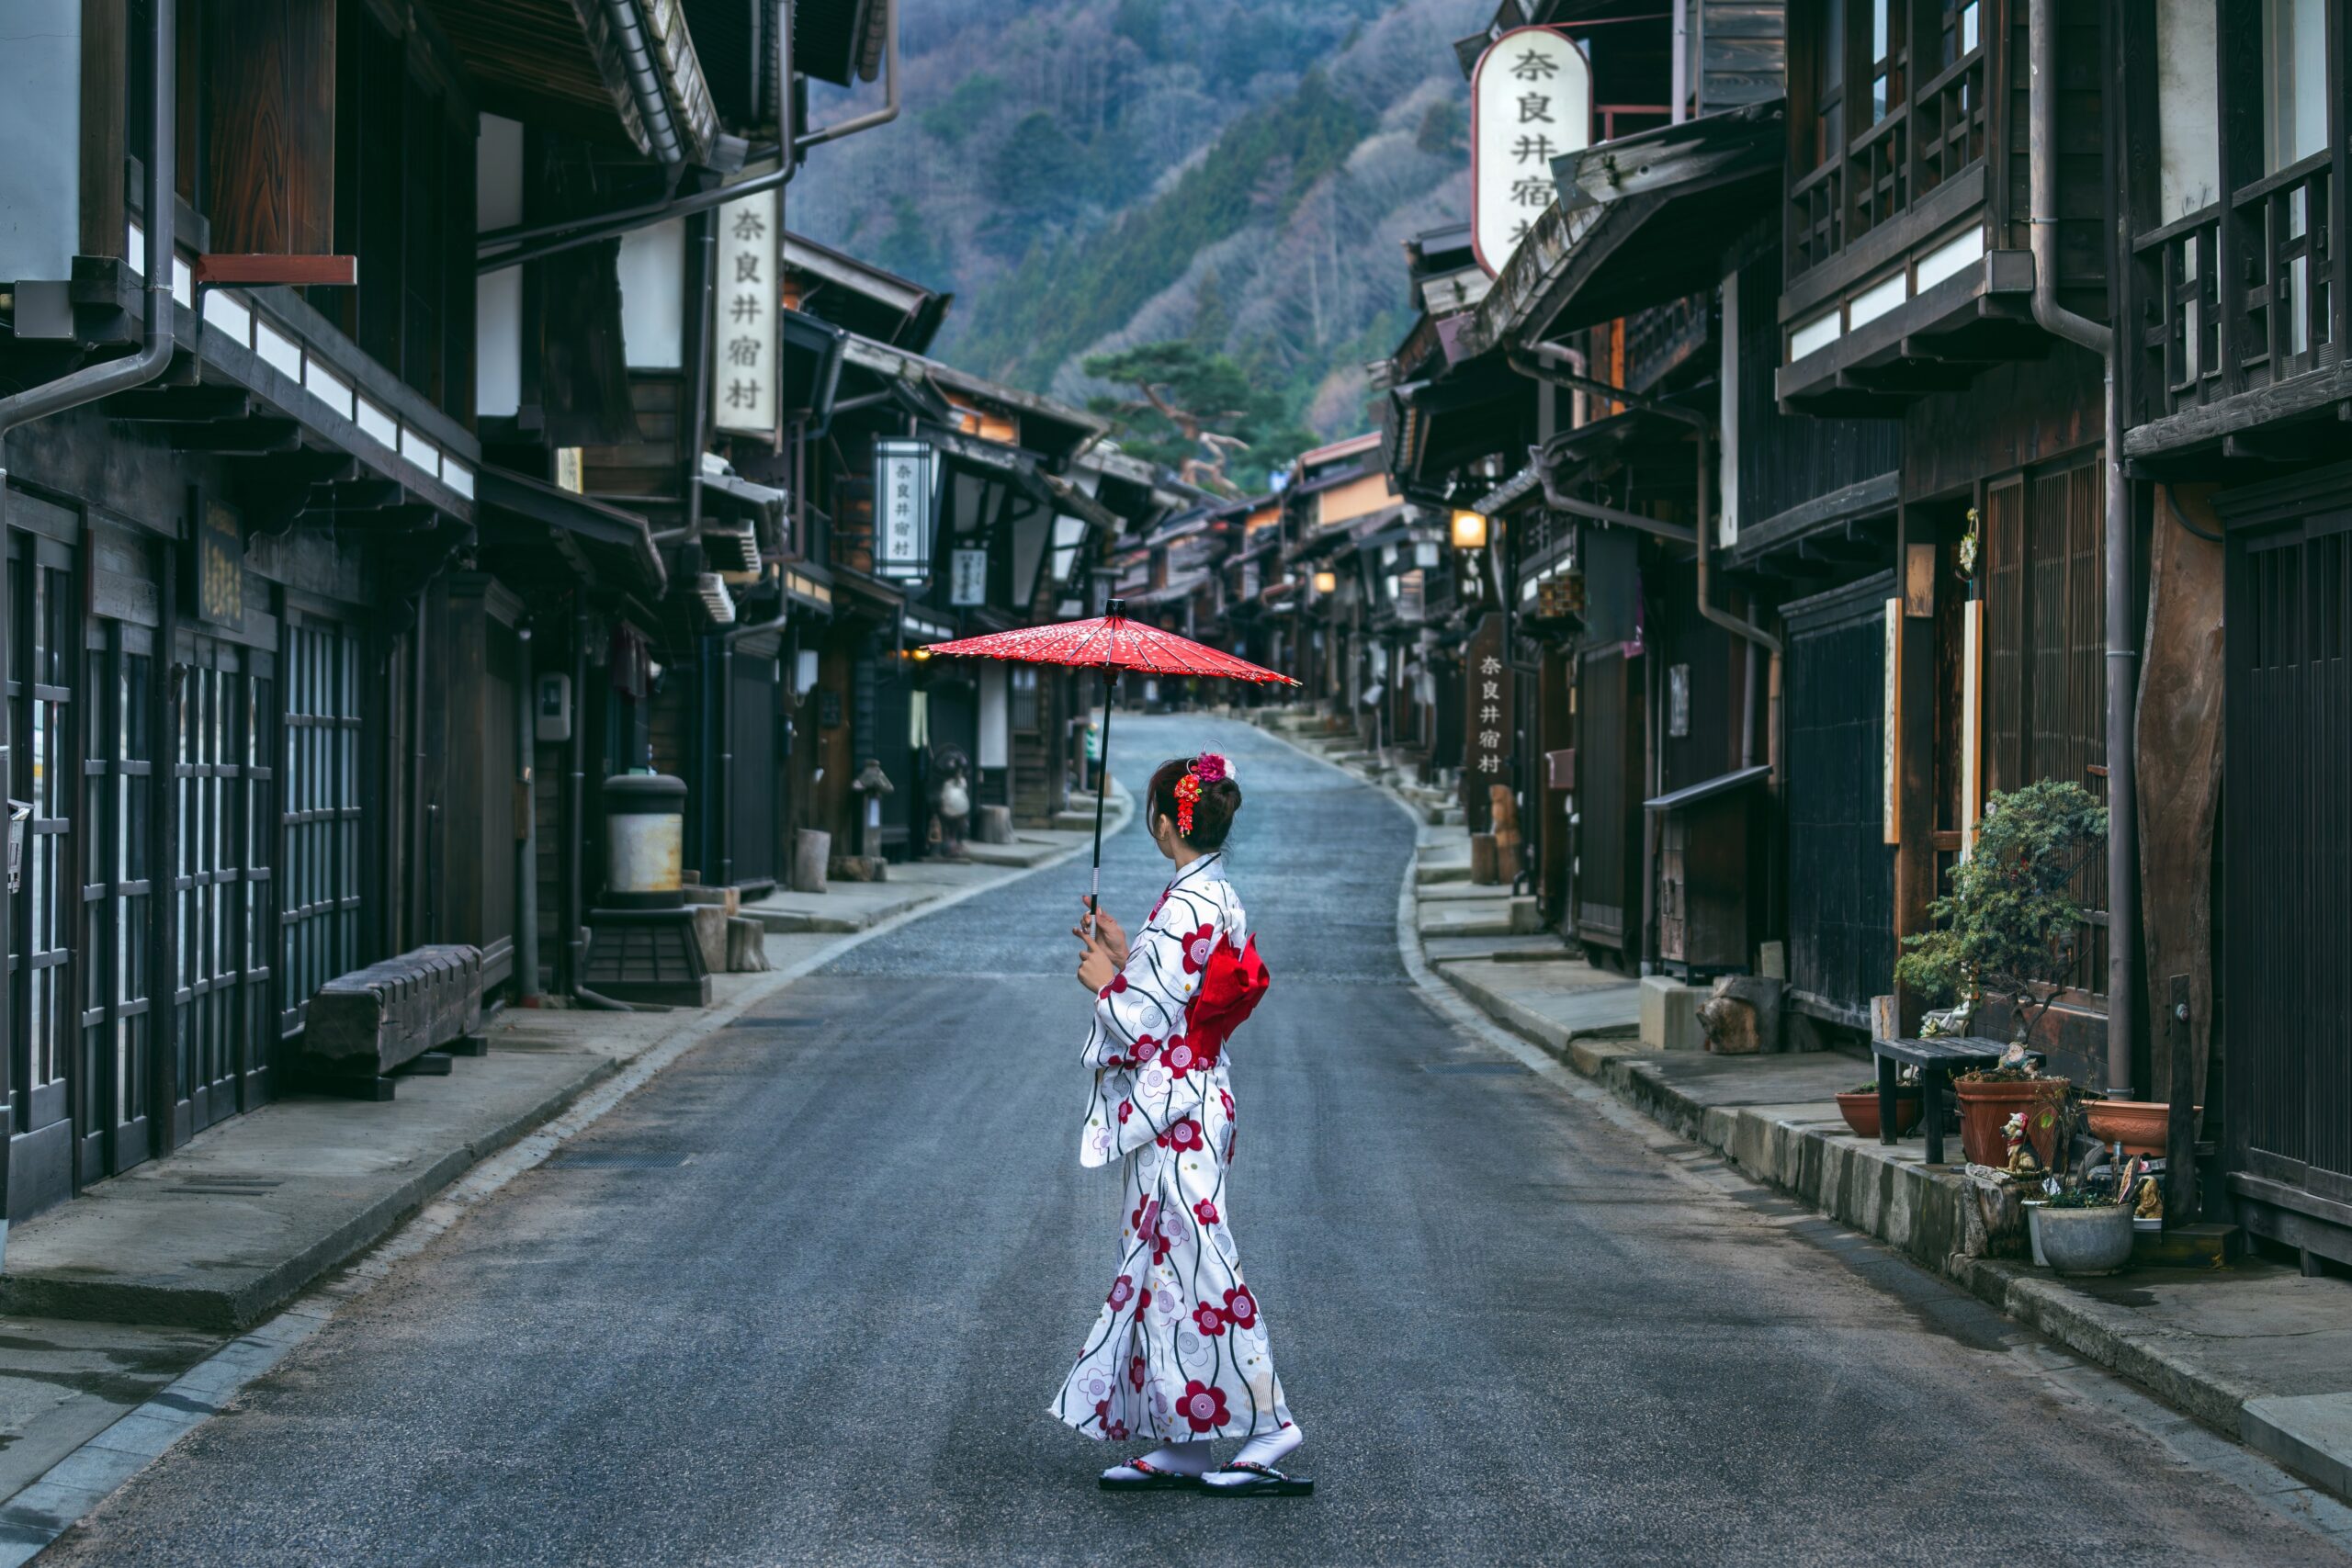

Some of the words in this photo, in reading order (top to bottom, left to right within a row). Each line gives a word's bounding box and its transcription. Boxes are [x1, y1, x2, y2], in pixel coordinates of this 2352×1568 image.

[725, 208, 766, 410] 奈良井宿村
[893, 464, 911, 557] 奈良井宿村
[1477, 655, 1502, 773] 奈良井宿村
